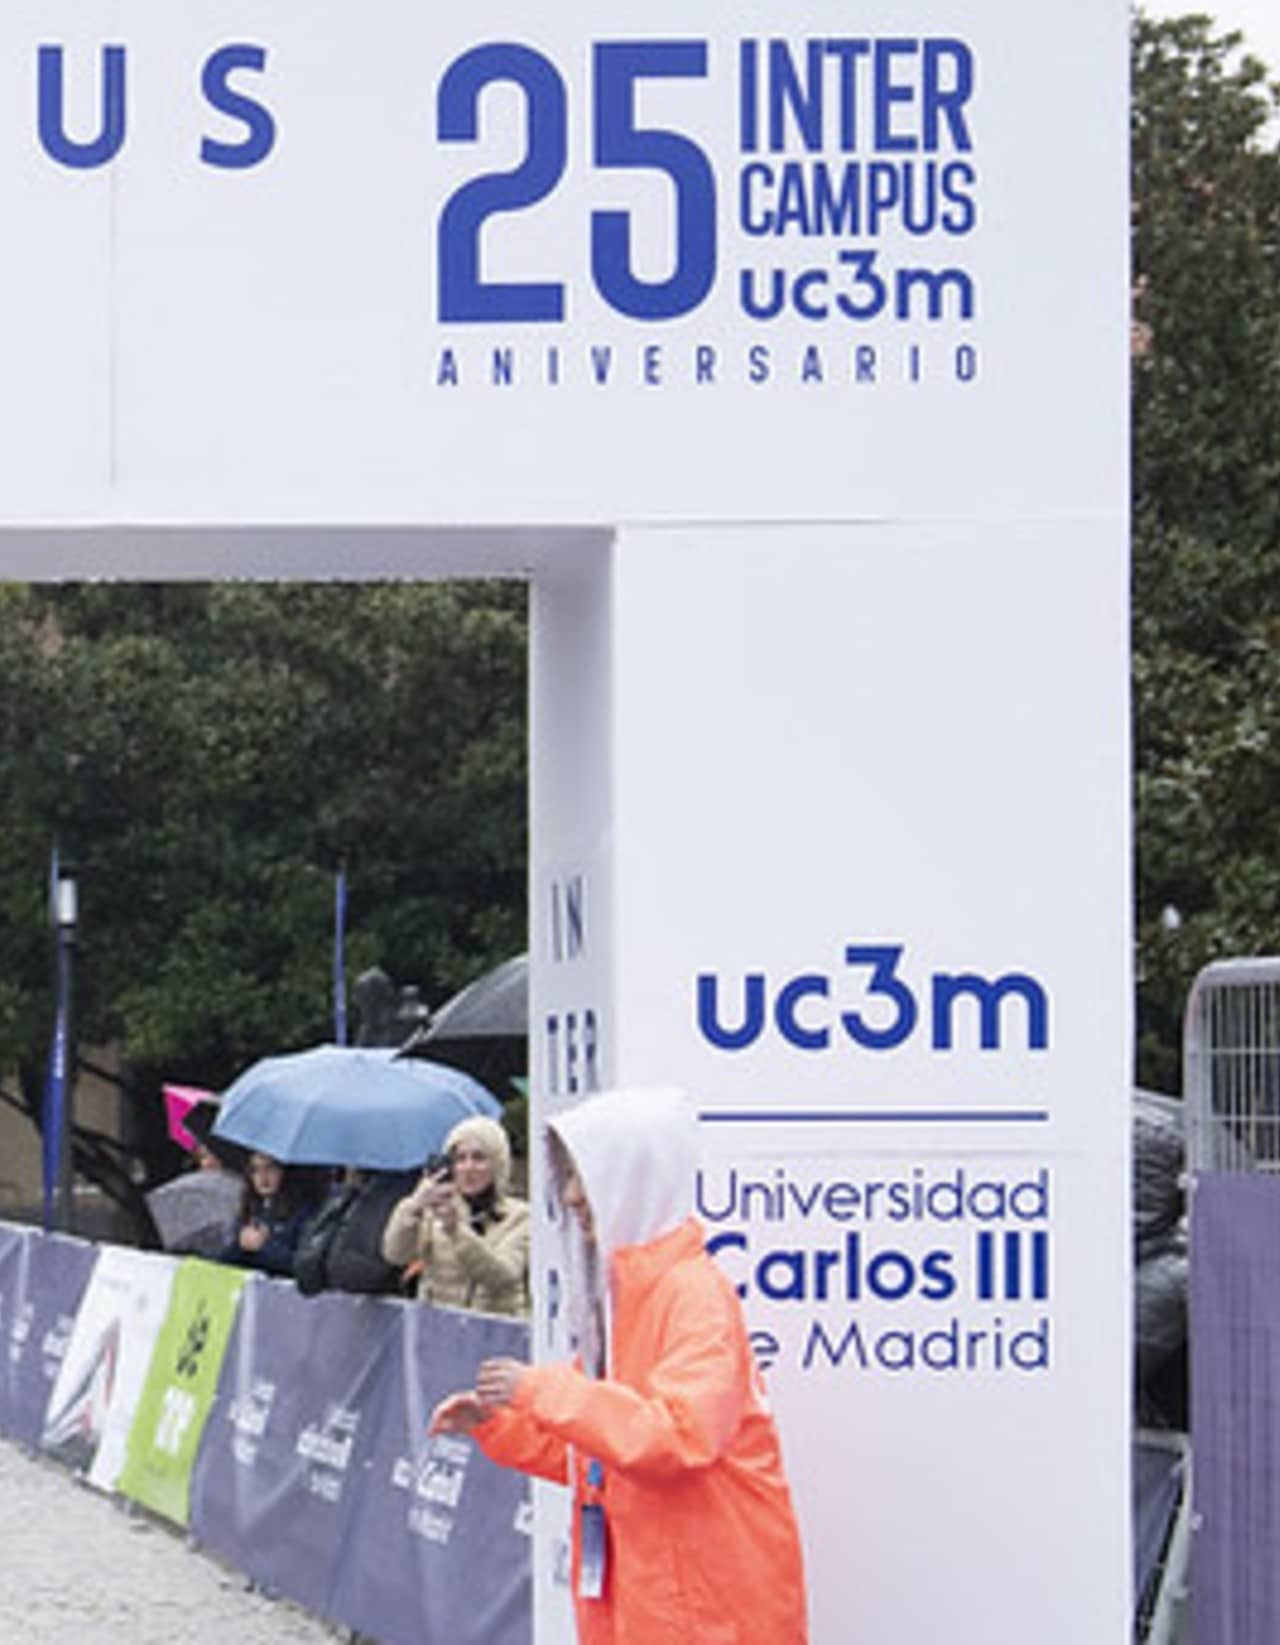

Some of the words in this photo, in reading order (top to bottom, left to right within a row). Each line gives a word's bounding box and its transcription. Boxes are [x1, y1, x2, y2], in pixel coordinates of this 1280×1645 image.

[737, 36, 977, 157] INTER
[433, 37, 720, 327] 25
[736, 159, 978, 239] CAMPUS
[737, 247, 977, 324] uc3m
[436, 343, 976, 388] ANIVERSARIO
[549, 873, 584, 963] IN
[695, 942, 1050, 1054] uc3m
[695, 1170, 1050, 1223] Universidad
[974, 1228, 1050, 1304] III
[748, 1330, 782, 1371] e
[801, 1317, 1050, 1371] Madrid
